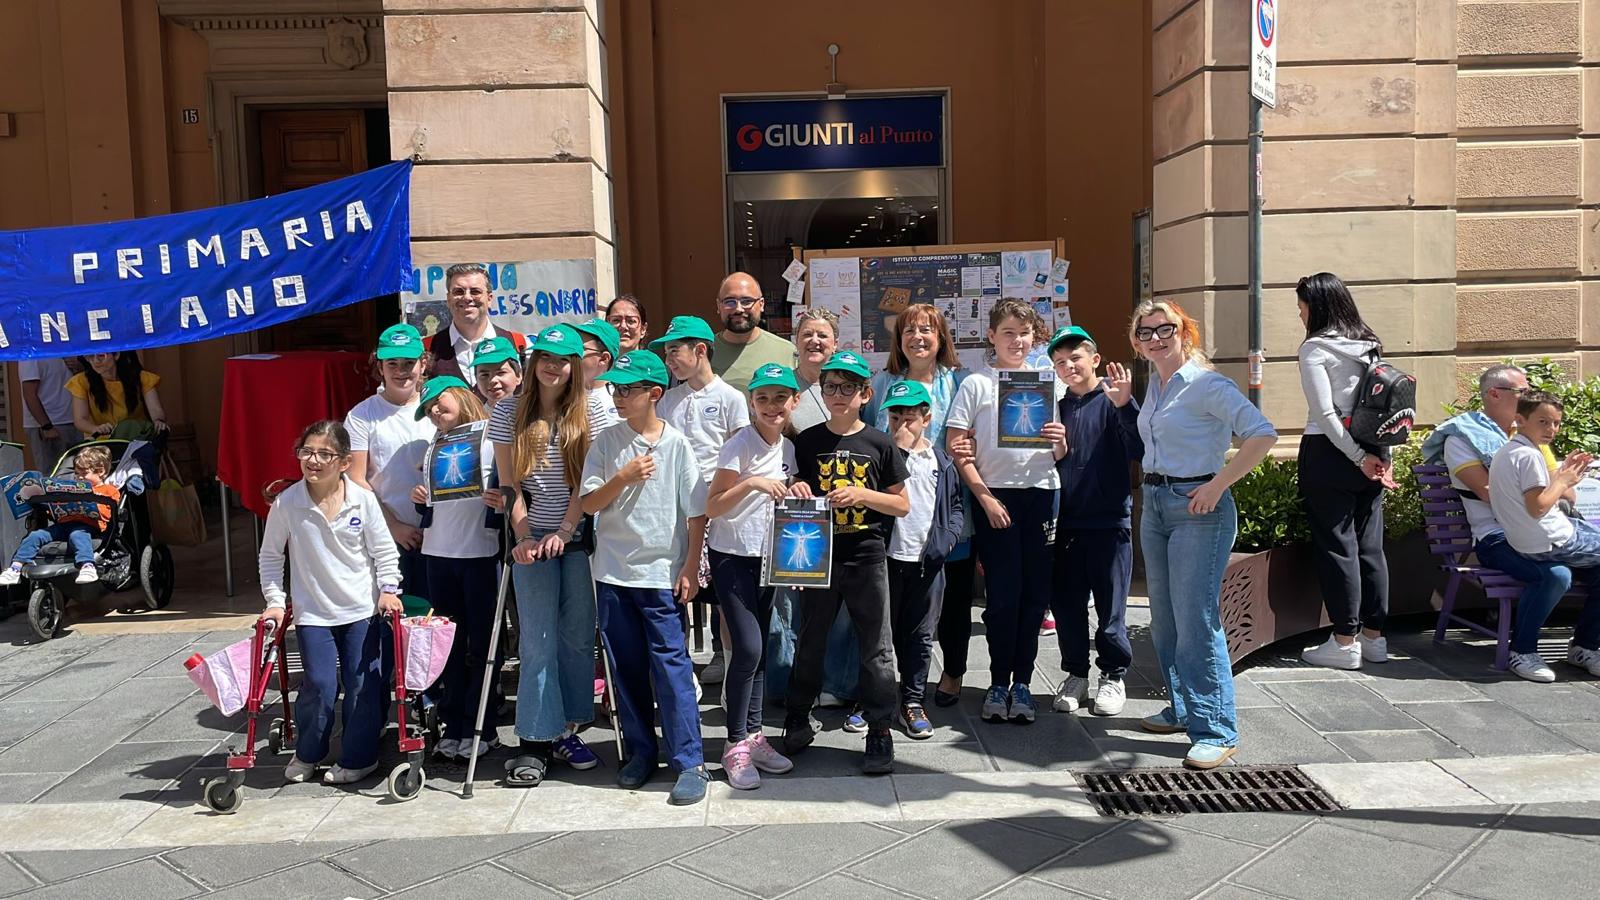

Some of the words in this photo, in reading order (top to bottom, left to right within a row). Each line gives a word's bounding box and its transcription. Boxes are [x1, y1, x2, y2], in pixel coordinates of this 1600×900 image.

[185, 110, 197, 123] 15
[765, 122, 853, 146] GIUNTI
[860, 127, 874, 144] al
[882, 126, 932, 144] Punto
[73, 200, 372, 284] PRIMARIA
[0, 275, 307, 348] NCIANO
[488, 288, 596, 317] LESSANDRIA
